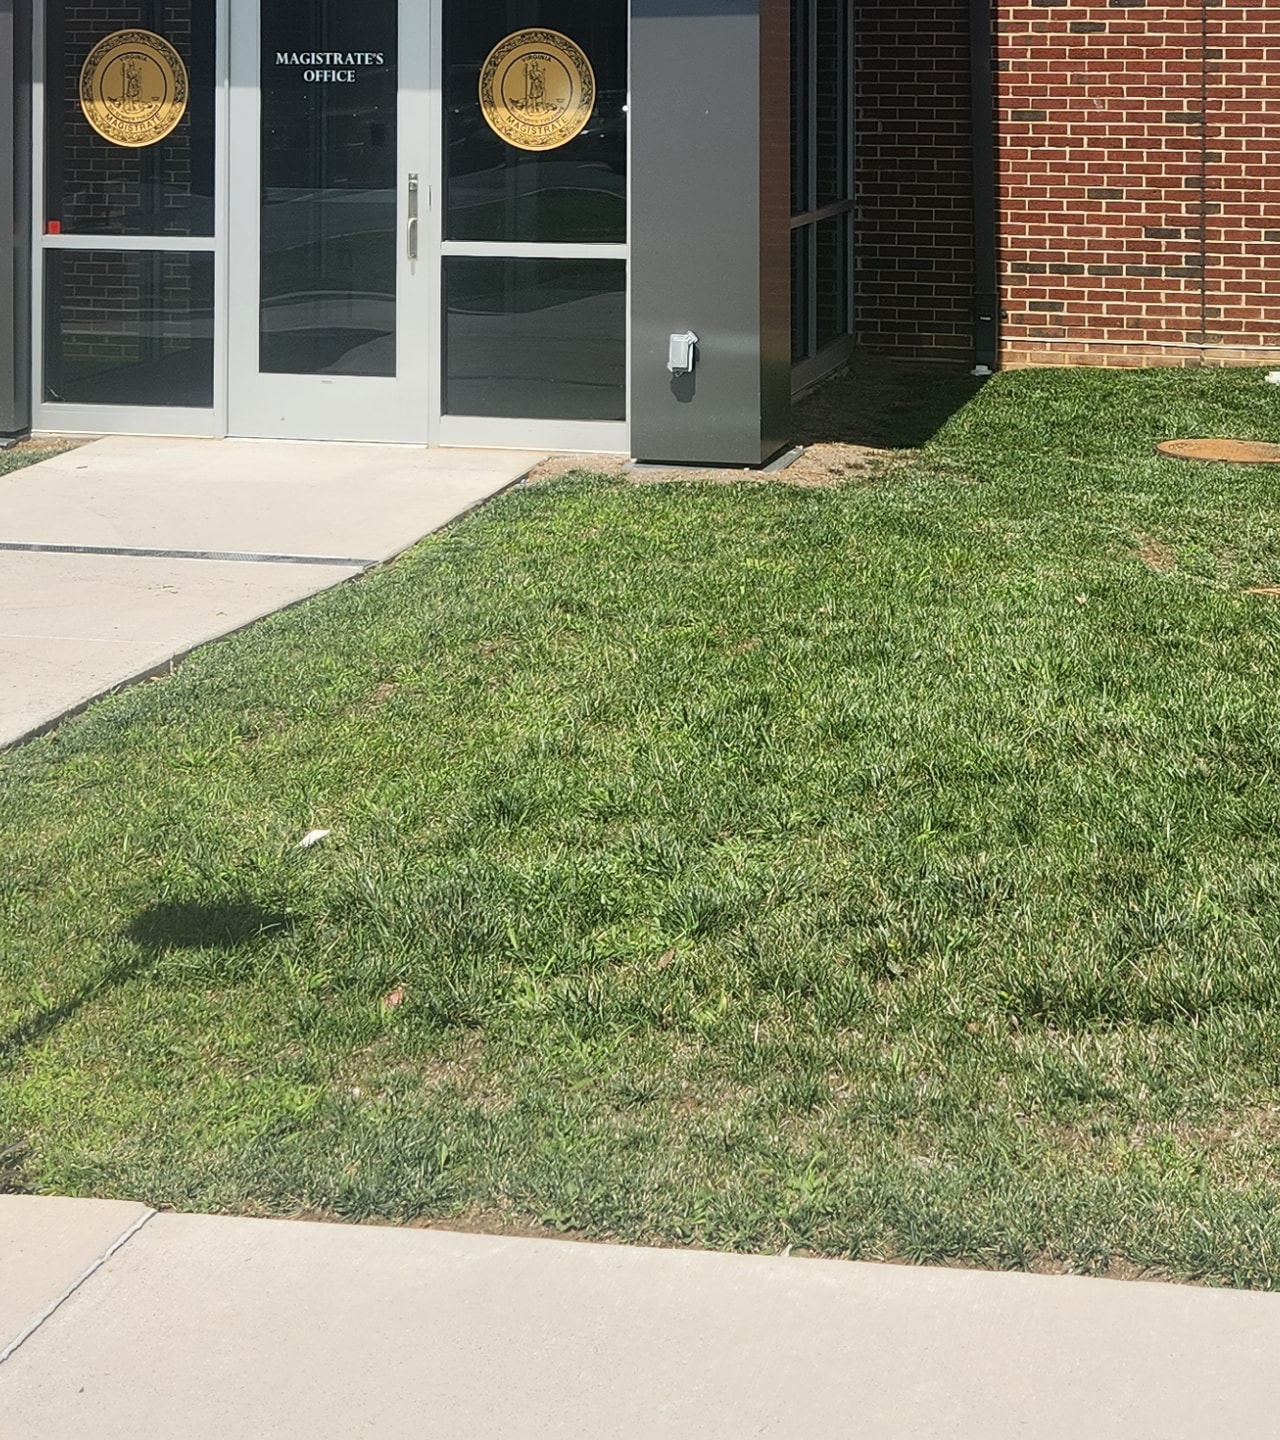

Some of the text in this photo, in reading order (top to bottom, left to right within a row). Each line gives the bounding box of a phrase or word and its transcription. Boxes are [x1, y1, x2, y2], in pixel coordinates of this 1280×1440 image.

[275, 52, 384, 65] MAGISTRATE'S
[521, 54, 552, 63] VIRGINIA
[303, 69, 356, 83] OFFICE
[104, 112, 162, 132] MAGISTRATE
[505, 114, 568, 135] MAGISTRATE
